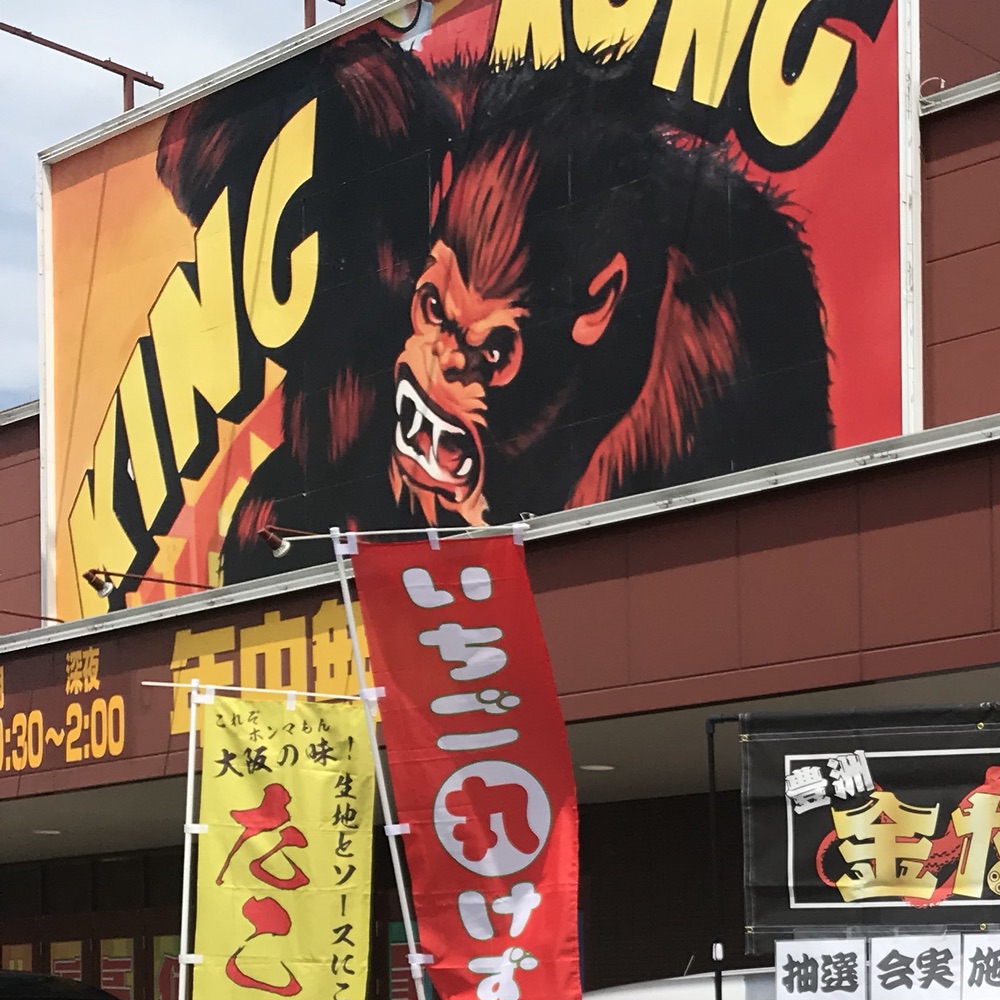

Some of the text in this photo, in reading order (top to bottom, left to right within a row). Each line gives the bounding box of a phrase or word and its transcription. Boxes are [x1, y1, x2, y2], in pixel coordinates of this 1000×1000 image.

[66, 647, 100, 694] 深夜
[0, 694, 125, 772] :30～2:00
[214, 710, 261, 728] これぞ
[249, 718, 331, 742] ホンマもん
